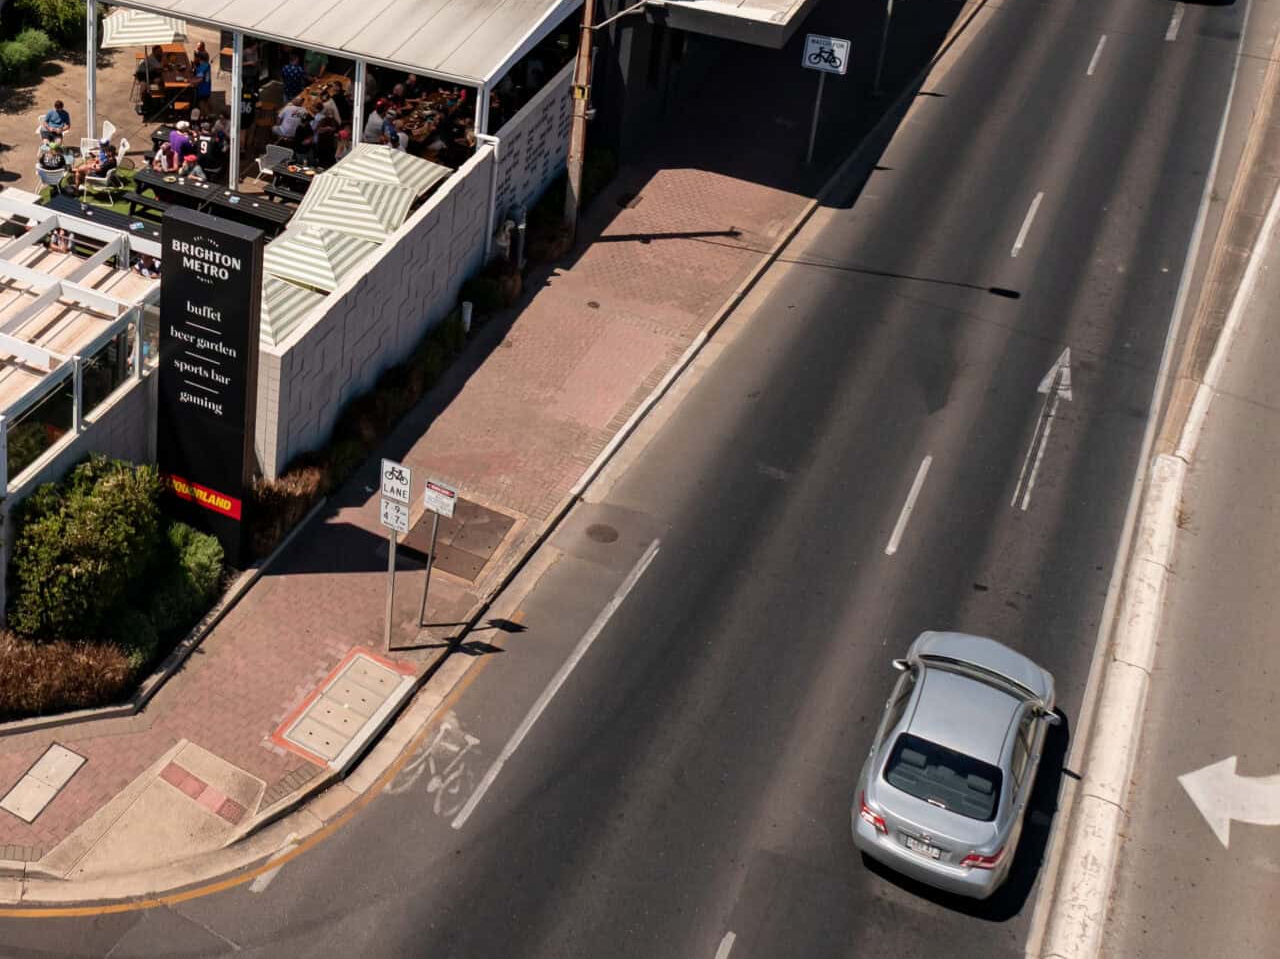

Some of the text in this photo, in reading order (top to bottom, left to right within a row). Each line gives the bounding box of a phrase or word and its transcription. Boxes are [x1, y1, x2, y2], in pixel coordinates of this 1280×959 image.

[200, 141, 208, 154] 9
[172, 239, 241, 271] BRIGHTON
[182, 256, 229, 280] METRO
[186, 300, 222, 322] buffet
[170, 325, 237, 358] beer garden
[174, 360, 231, 385] sports bar
[179, 391, 223, 415] gaming
[383, 483, 408, 499] LANE
